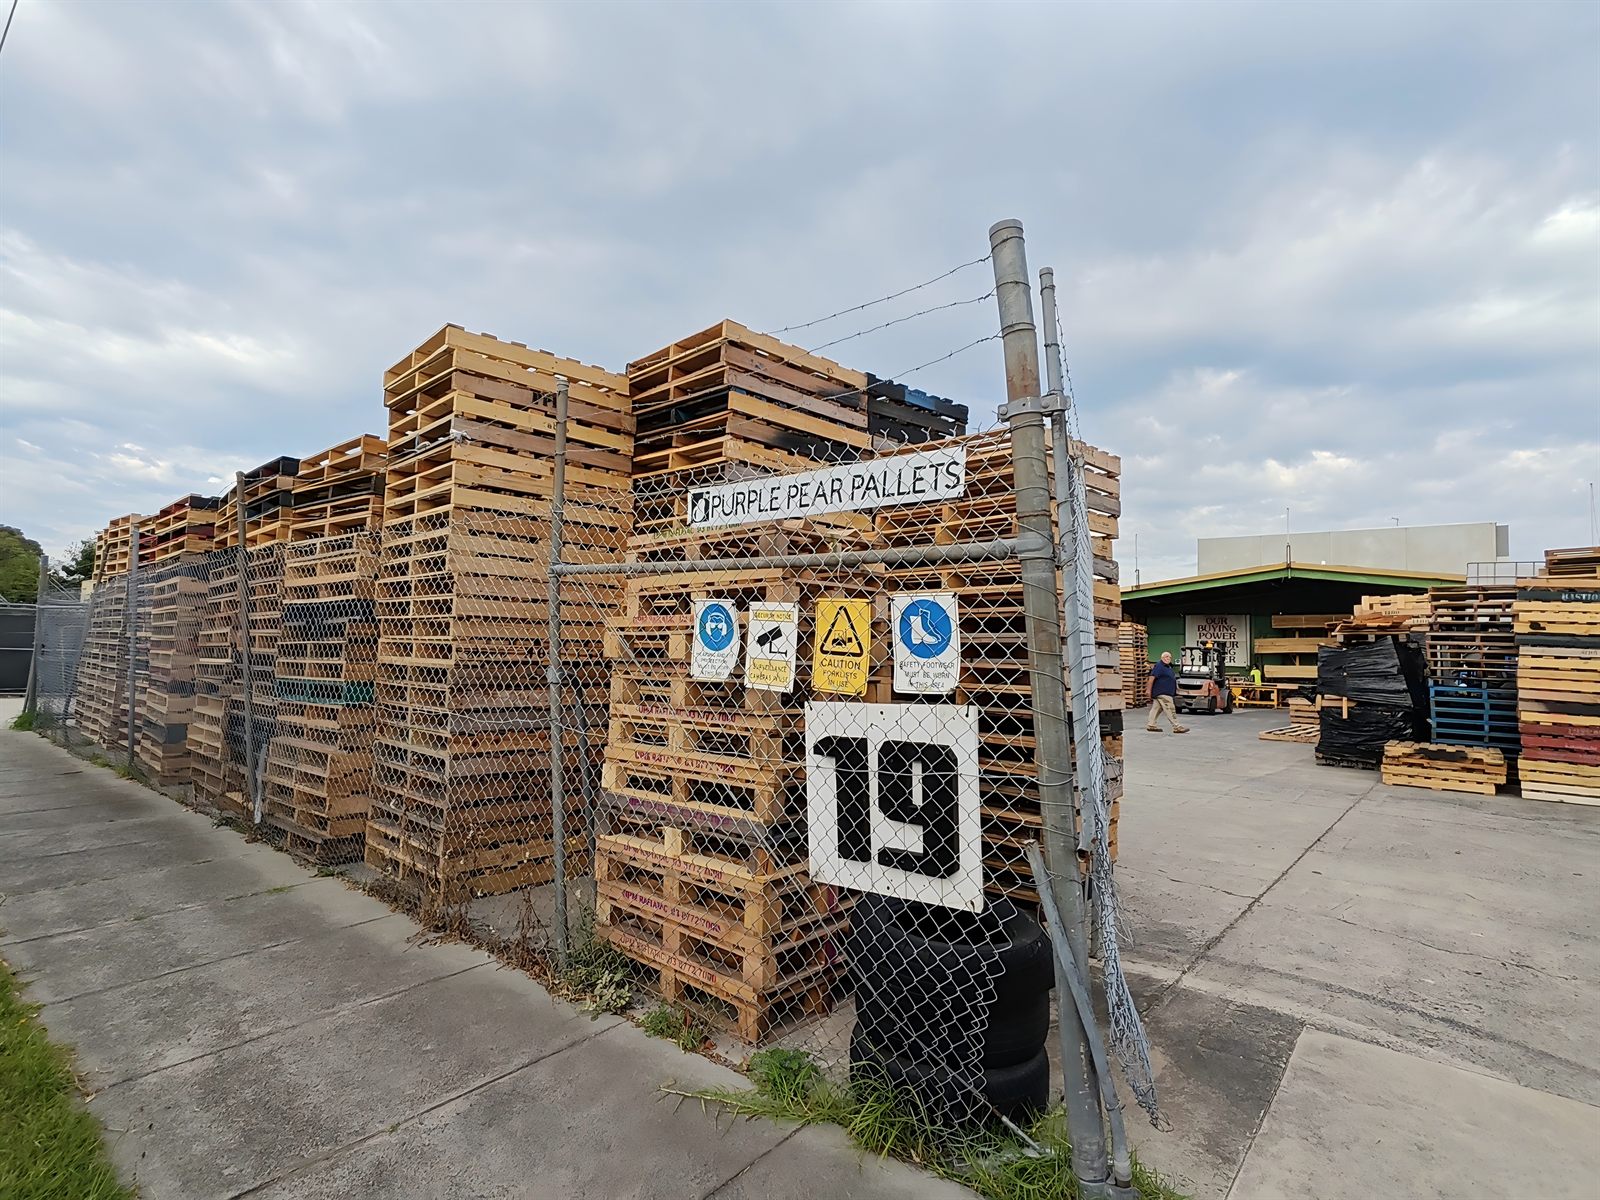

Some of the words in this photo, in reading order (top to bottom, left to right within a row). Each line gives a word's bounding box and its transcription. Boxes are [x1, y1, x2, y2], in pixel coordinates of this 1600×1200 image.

[711, 486, 781, 518] PURPLE
[786, 477, 843, 510] PEAR
[851, 460, 961, 500] PALLETS
[1205, 616, 1228, 625] OUR
[1197, 624, 1237, 632] BUYING
[1198, 632, 1236, 640] POWER
[820, 657, 861, 670] CAUTION
[922, 661, 955, 669] FOOTWEAR
[813, 735, 960, 879] 19
